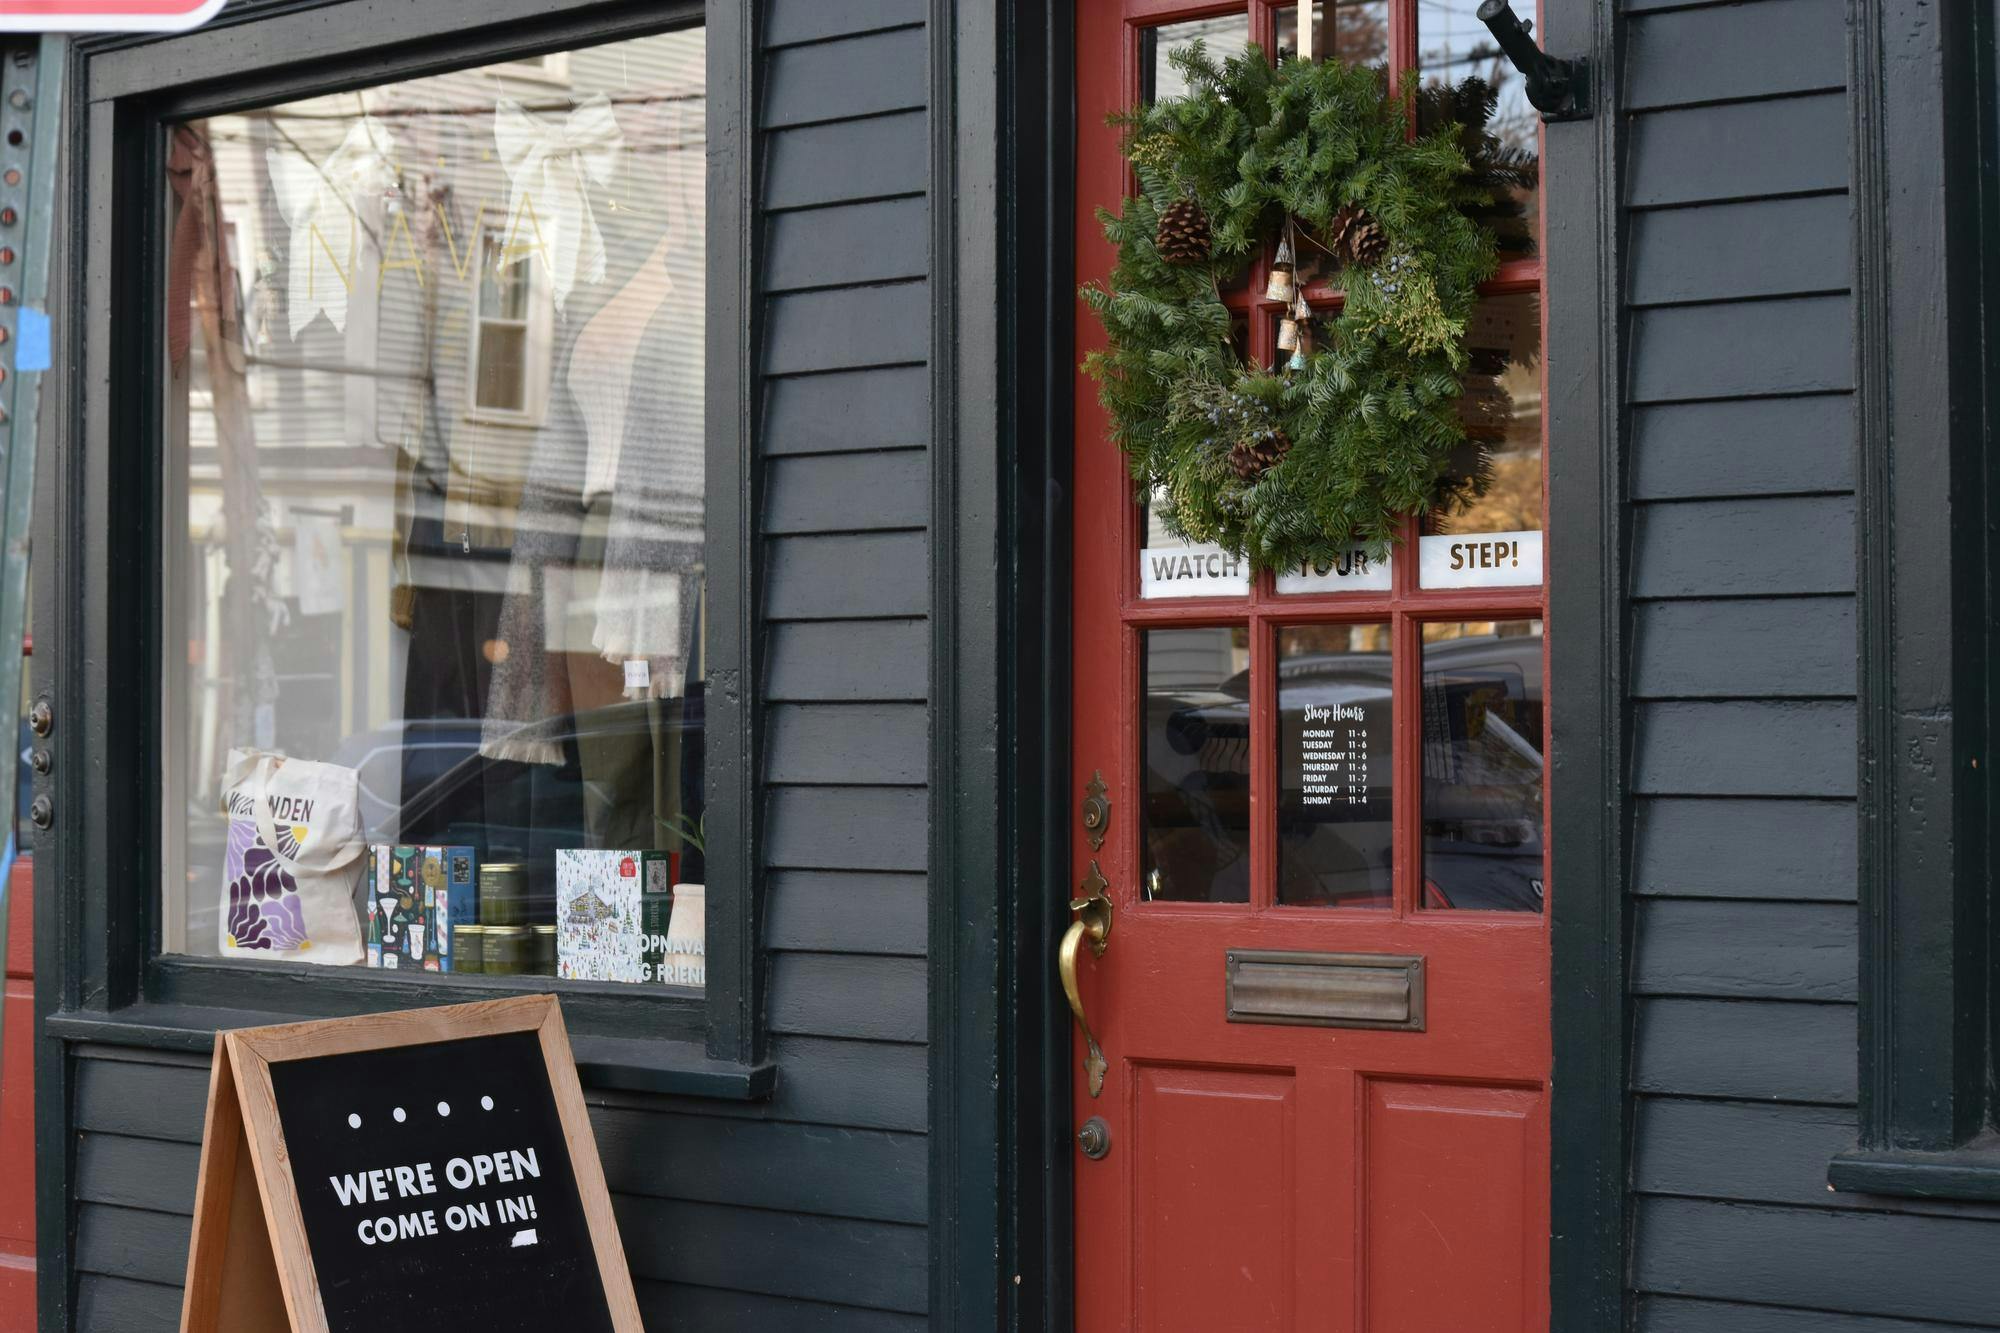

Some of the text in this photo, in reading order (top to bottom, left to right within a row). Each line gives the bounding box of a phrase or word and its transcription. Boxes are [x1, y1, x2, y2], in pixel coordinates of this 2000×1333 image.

[308, 191, 553, 300] NAVA
[1151, 552, 1240, 581] WATCH
[1450, 541, 1519, 571] STEP!
[1304, 703, 1365, 725] Shop Hours
[1302, 730, 1334, 738] MONDAY
[1348, 730, 1356, 738] 11
[1362, 730, 1367, 738] 6
[1302, 741, 1332, 749] TUESDAY
[1348, 741, 1356, 749] 11
[1362, 741, 1367, 749] 6
[1302, 752, 1346, 760] WEDNESDAY
[1348, 752, 1356, 760] 11
[1362, 752, 1367, 760] 6
[1302, 763, 1339, 771] THURSDAY
[1348, 763, 1356, 771] 11
[1362, 763, 1367, 771] 6
[1302, 774, 1327, 782] FRIDAY
[1348, 774, 1356, 782] 11
[1362, 774, 1367, 782] 7
[1302, 786, 1338, 794] SATURDAY
[1348, 786, 1356, 794] 11
[1362, 786, 1367, 794] 7
[1302, 796, 1332, 804] SUNDAY
[1348, 796, 1356, 804] 11
[1362, 796, 1367, 804] 4
[329, 1147, 541, 1206] WE'RE OPEN
[357, 1195, 538, 1245] COME ON IN!
